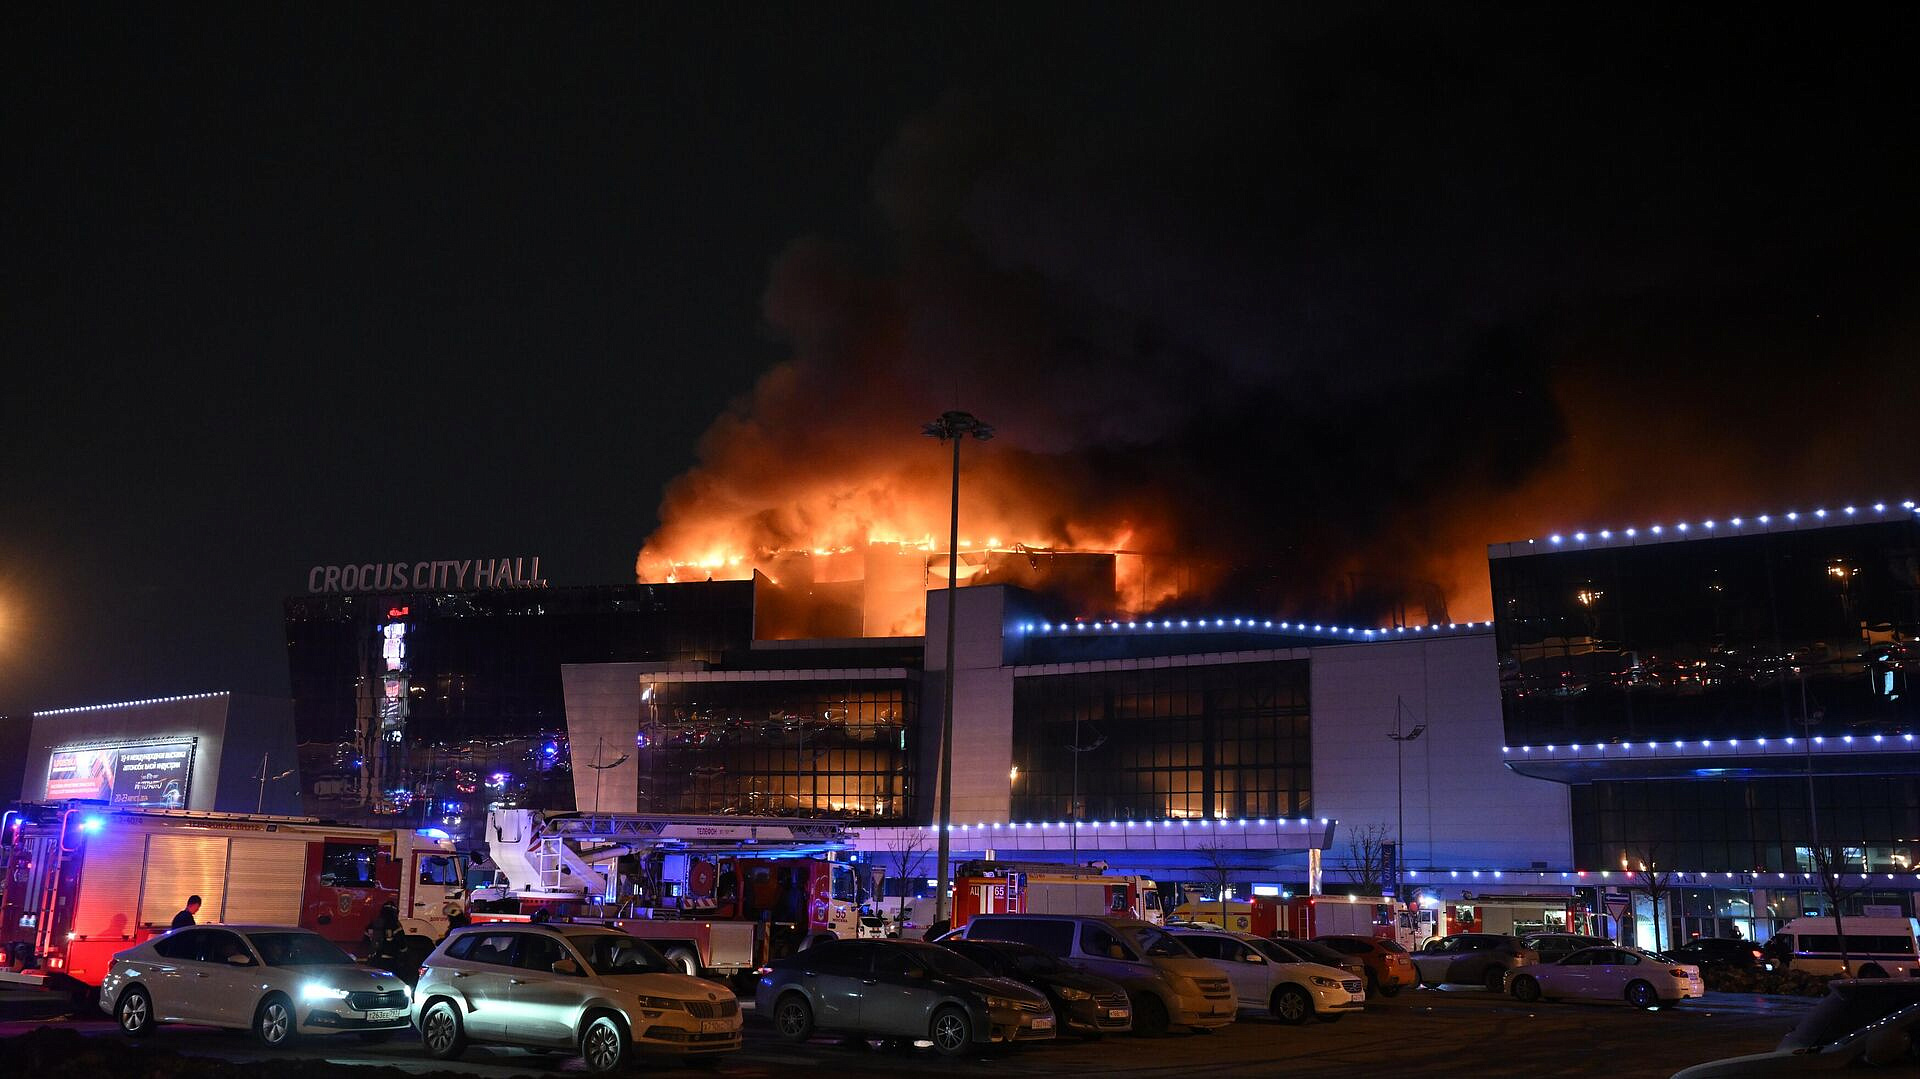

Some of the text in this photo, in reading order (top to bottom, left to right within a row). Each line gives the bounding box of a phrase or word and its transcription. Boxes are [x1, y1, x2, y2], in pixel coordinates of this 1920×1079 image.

[308, 556, 548, 593] CROCUS CITY HALL
[994, 886, 1005, 896] 65
[835, 910, 846, 919] 55
